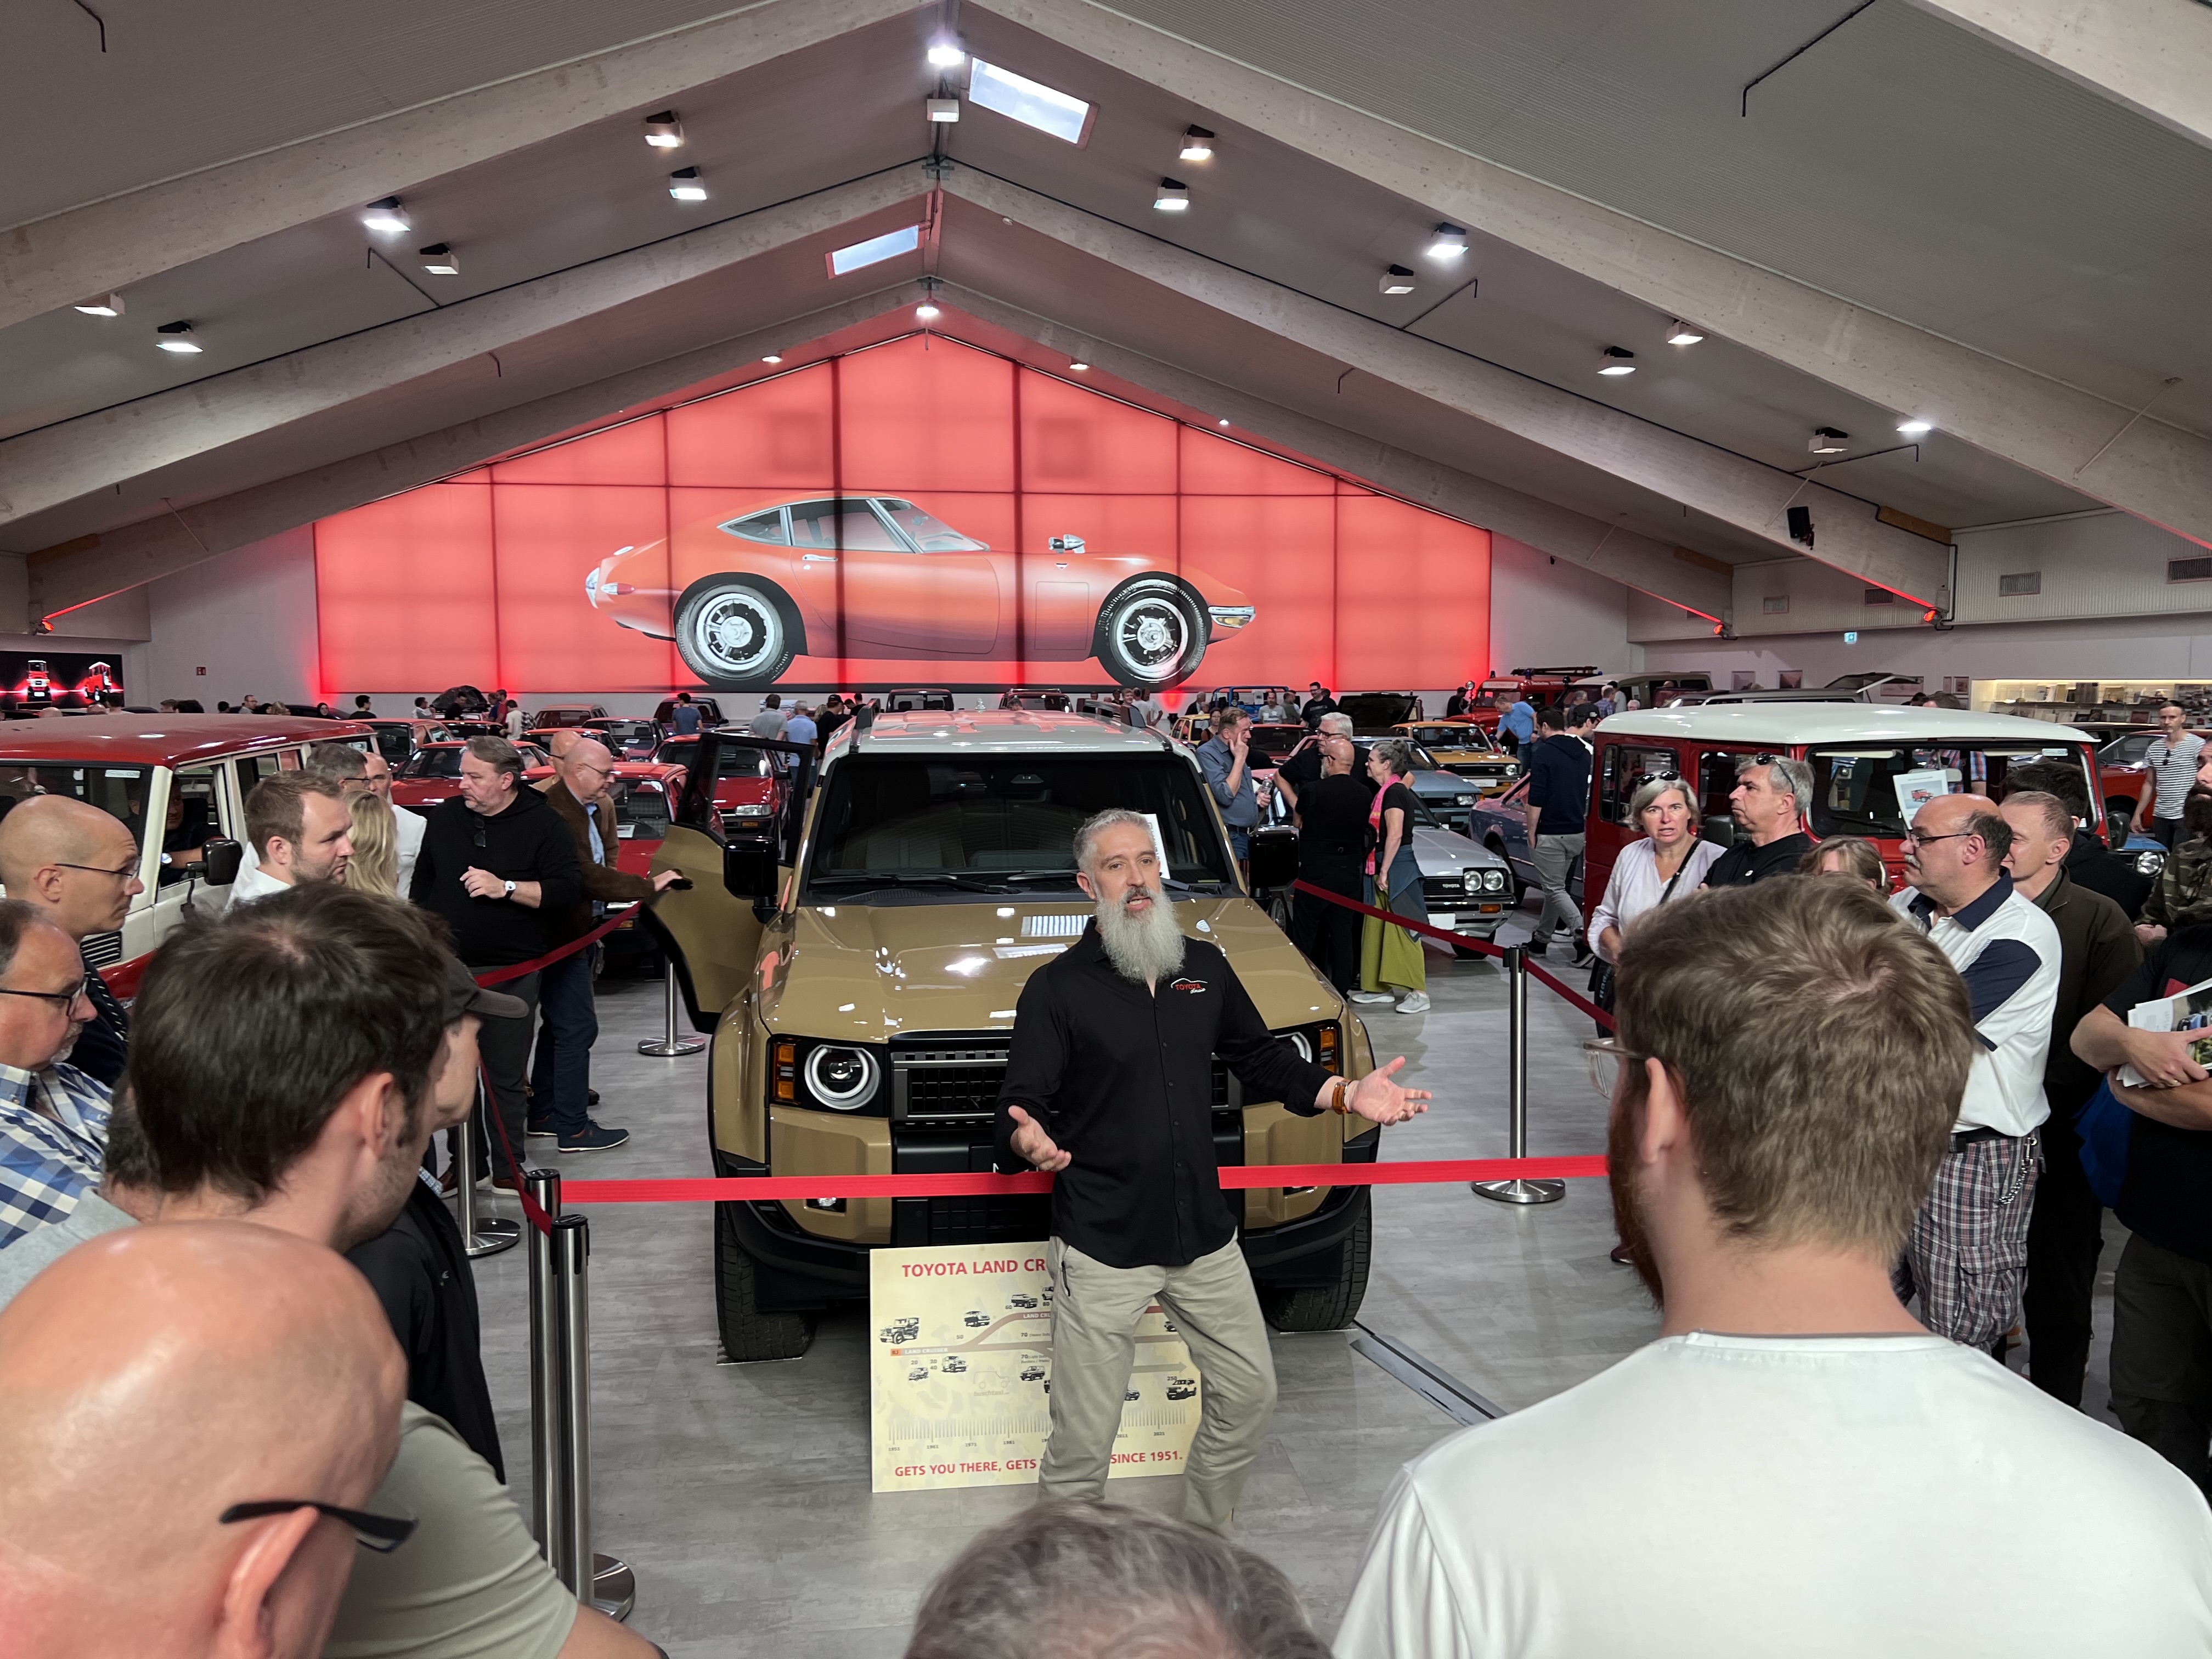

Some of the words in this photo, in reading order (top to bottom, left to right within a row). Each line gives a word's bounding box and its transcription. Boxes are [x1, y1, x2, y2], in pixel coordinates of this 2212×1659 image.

[902, 1262, 967, 1277] TOYOTA
[973, 1260, 1018, 1274] LAND
[895, 1465, 926, 1476] GETS
[929, 1464, 955, 1475] YOU
[960, 1461, 1001, 1472] THERE,
[1006, 1458, 1036, 1470] GETS
[1110, 1452, 1146, 1464] SINCE
[1150, 1451, 1183, 1462] 1951.
